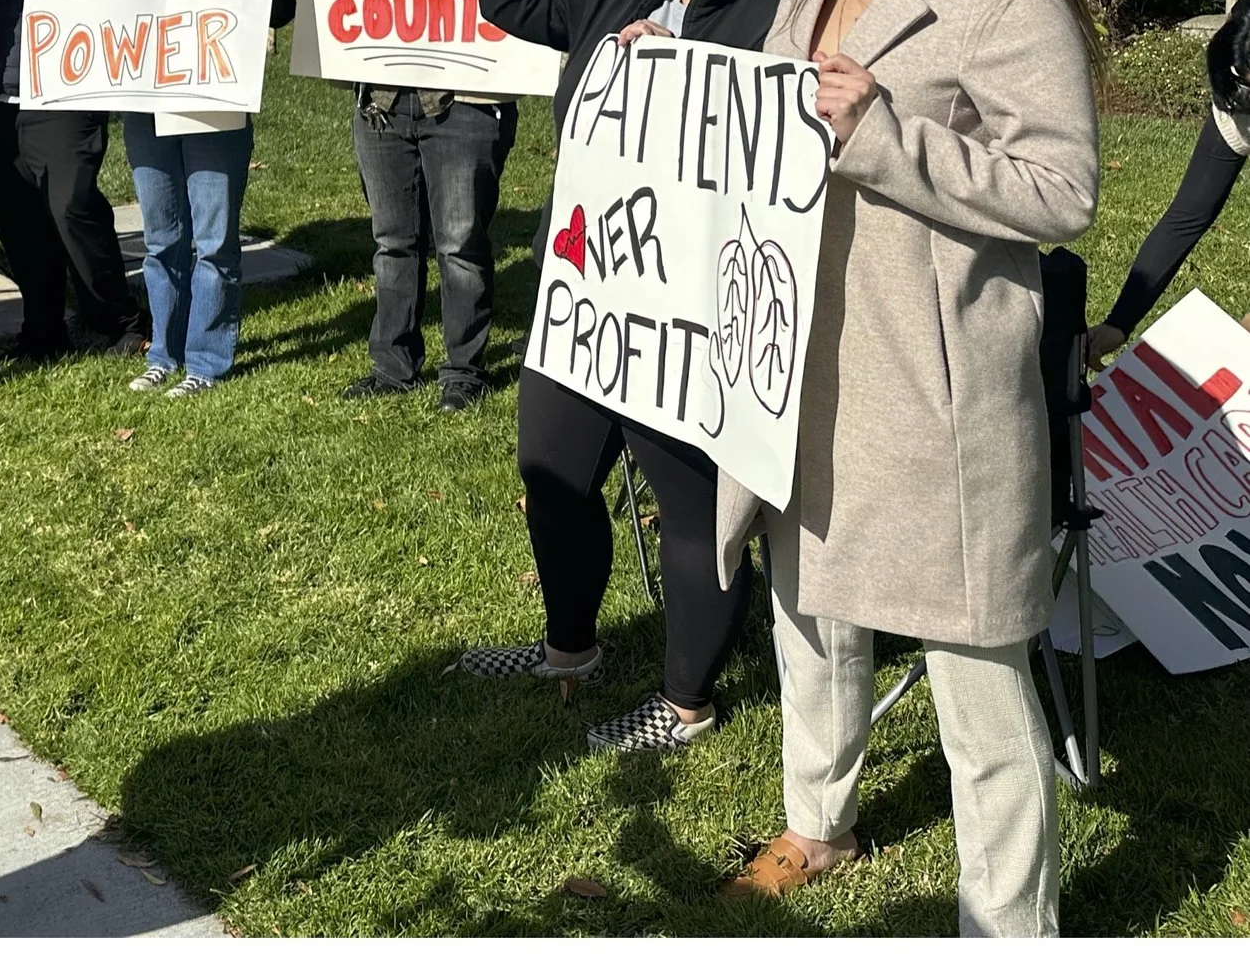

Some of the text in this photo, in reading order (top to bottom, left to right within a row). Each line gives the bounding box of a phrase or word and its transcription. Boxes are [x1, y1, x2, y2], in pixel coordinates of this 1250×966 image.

[26, 8, 238, 99] POWER
[570, 36, 832, 213] PATIENTS
[539, 279, 725, 438] PROFITS
